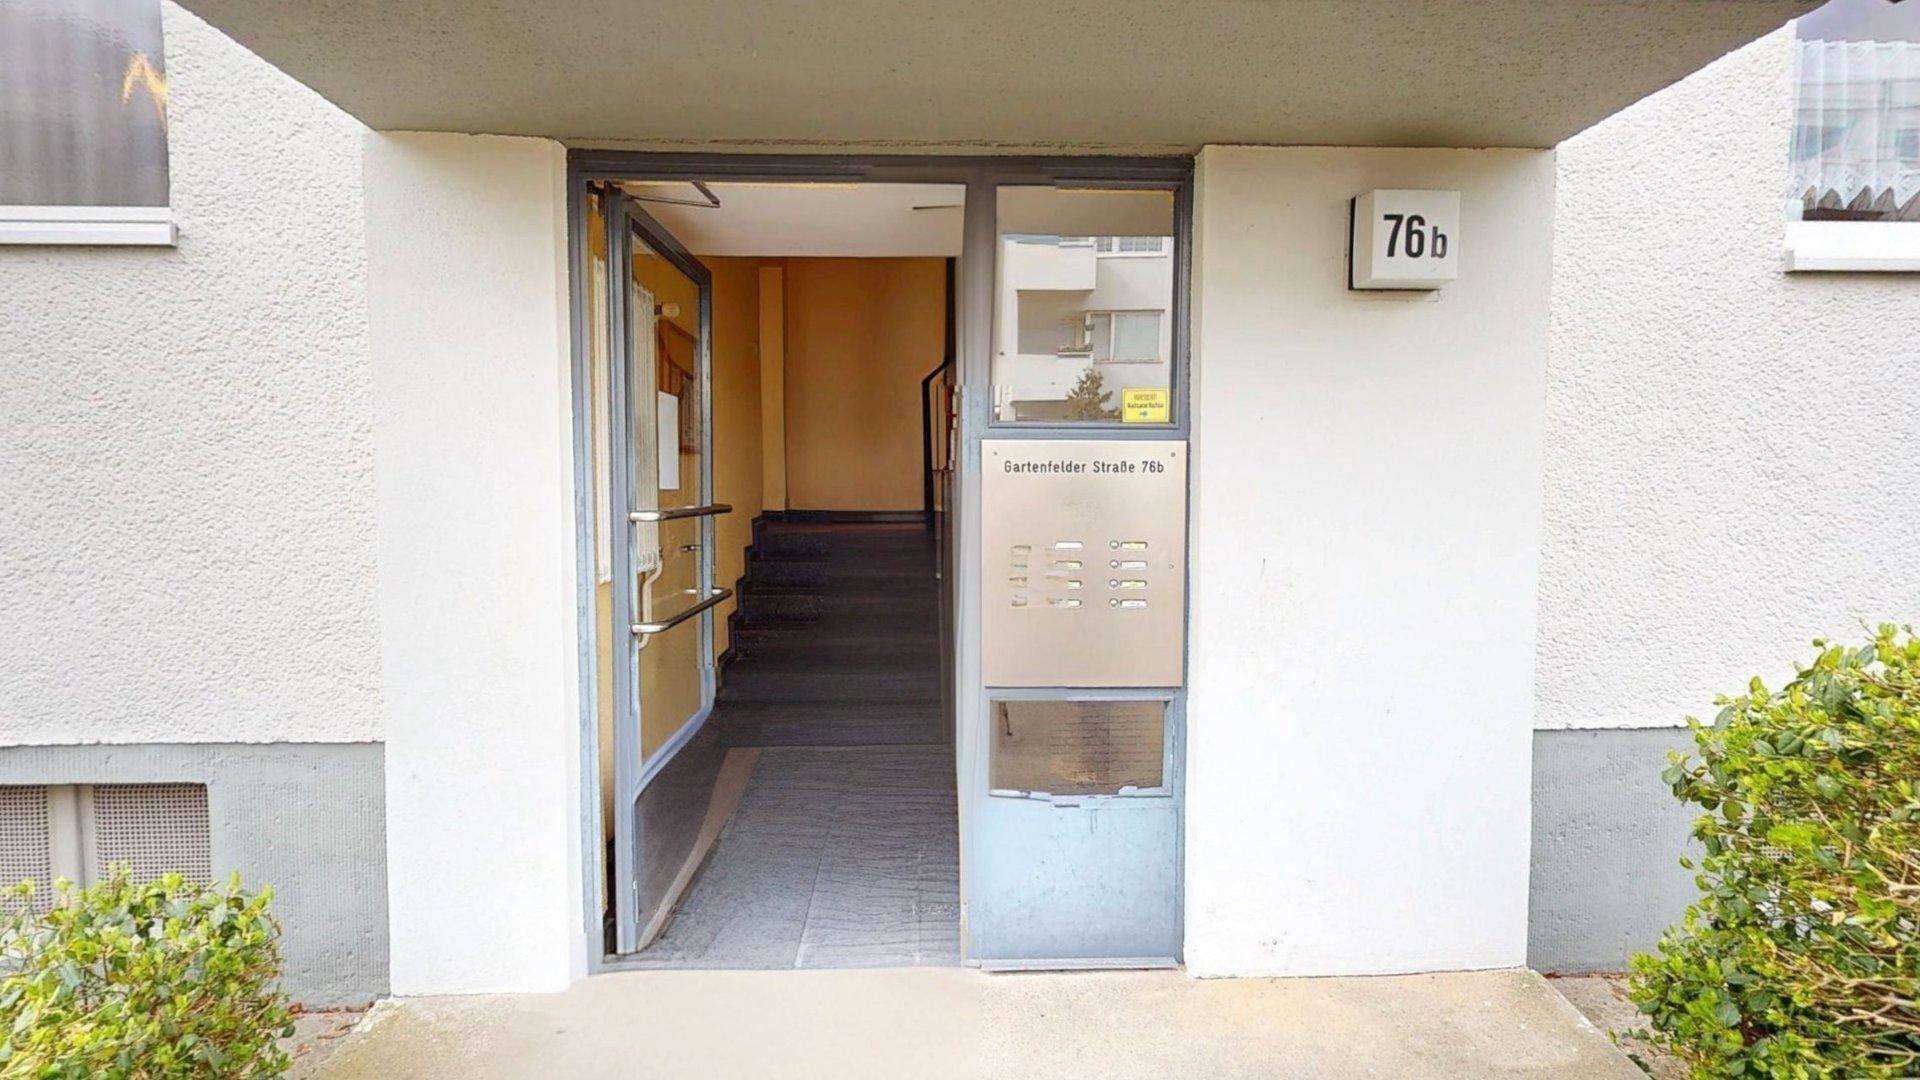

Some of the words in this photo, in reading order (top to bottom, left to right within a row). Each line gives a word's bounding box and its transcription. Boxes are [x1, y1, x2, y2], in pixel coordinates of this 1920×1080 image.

[1004, 460, 1086, 473] Gartenfelder
[1093, 460, 1135, 473] Straße
[1141, 460, 1164, 473] 76b
